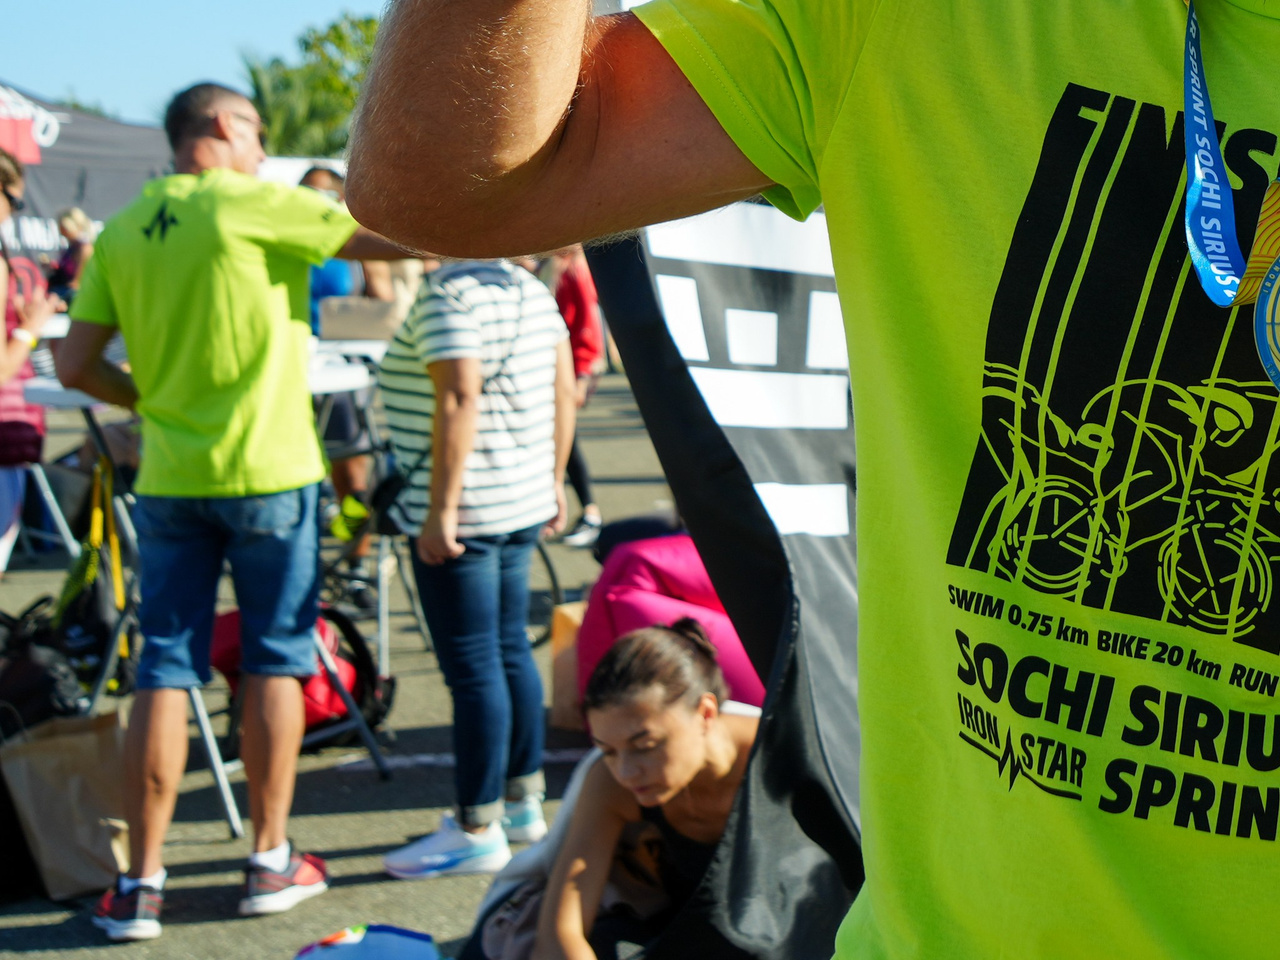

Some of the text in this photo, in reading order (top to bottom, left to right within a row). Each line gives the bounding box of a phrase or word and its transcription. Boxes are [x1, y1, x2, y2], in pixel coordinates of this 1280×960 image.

[1188, 43, 1208, 131] SPRINT
[1194, 133, 1222, 210] SOCHI
[1200, 215, 1240, 286] SIRIUS
[948, 584, 1006, 620] SWIM
[1007, 604, 1053, 636] 0.75
[1055, 616, 1090, 647] km
[1096, 629, 1150, 661] BIKE
[1152, 641, 1184, 668] 20
[1186, 649, 1222, 681] km
[1229, 663, 1280, 697] RUN
[954, 628, 1116, 737] SOCHI
[957, 692, 1088, 789] IRON STAR
